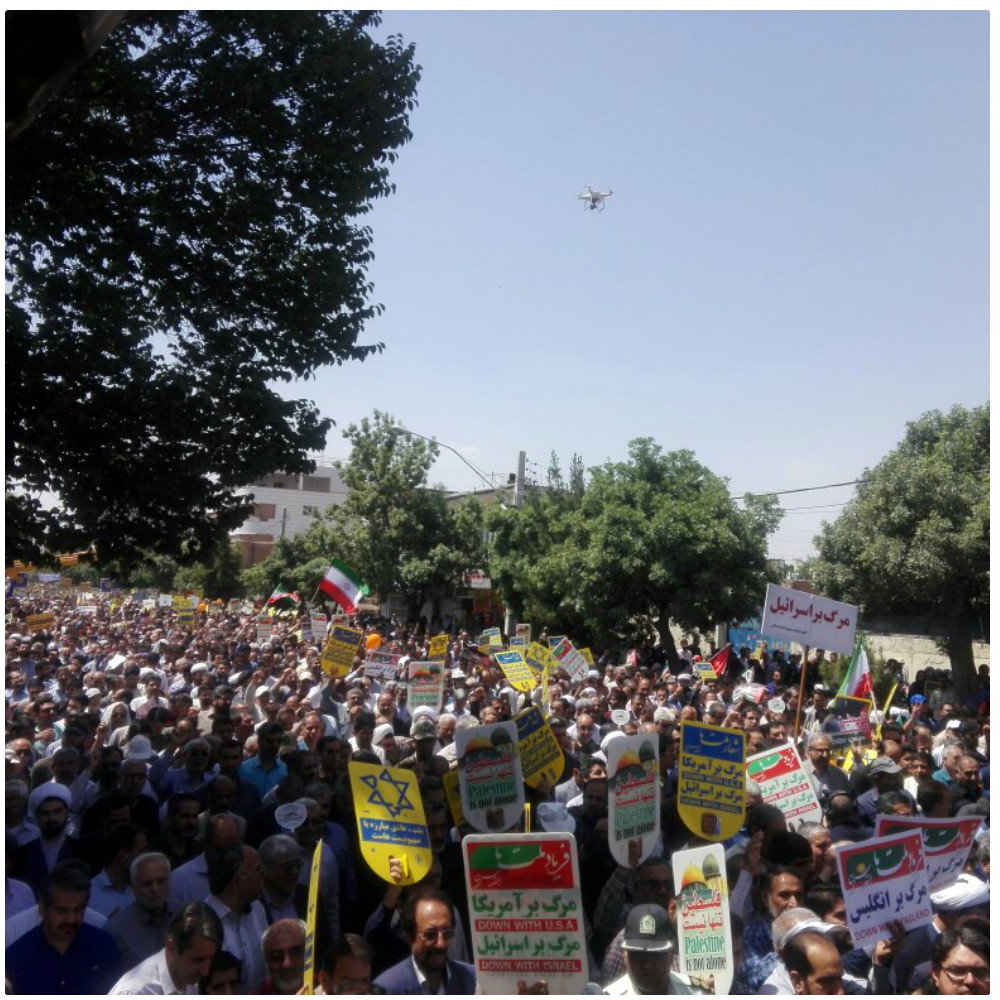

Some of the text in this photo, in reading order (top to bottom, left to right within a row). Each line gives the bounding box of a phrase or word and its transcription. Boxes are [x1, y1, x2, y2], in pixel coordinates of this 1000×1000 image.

[770, 596, 850, 629] مرگ بر اسرائیل
[682, 756, 712, 773] آمریکا
[714, 764, 722, 776] بر
[724, 764, 742, 780] مرگ
[469, 782, 517, 798] Palestine
[682, 782, 742, 804] مرگ بر اسرائیل
[470, 800, 477, 810] is
[478, 798, 492, 809] not
[616, 806, 656, 827] Palestine
[616, 822, 656, 842] is not alone
[905, 877, 928, 906] مرگ
[472, 892, 578, 918] مرگ بر آمریکا
[682, 888, 722, 917] فلسطین
[850, 890, 890, 924] انگلیس
[894, 892, 904, 912] بر
[478, 920, 574, 930] DOWN WITH U.S.A
[683, 912, 722, 934] تنها نیست
[684, 934, 725, 954] Palestine
[854, 926, 878, 942] DOWN
[477, 934, 580, 956] مرگ بر اسرائیل
[482, 960, 579, 970] DOWN WITH ISRAEL
[686, 955, 726, 972] is not alone
